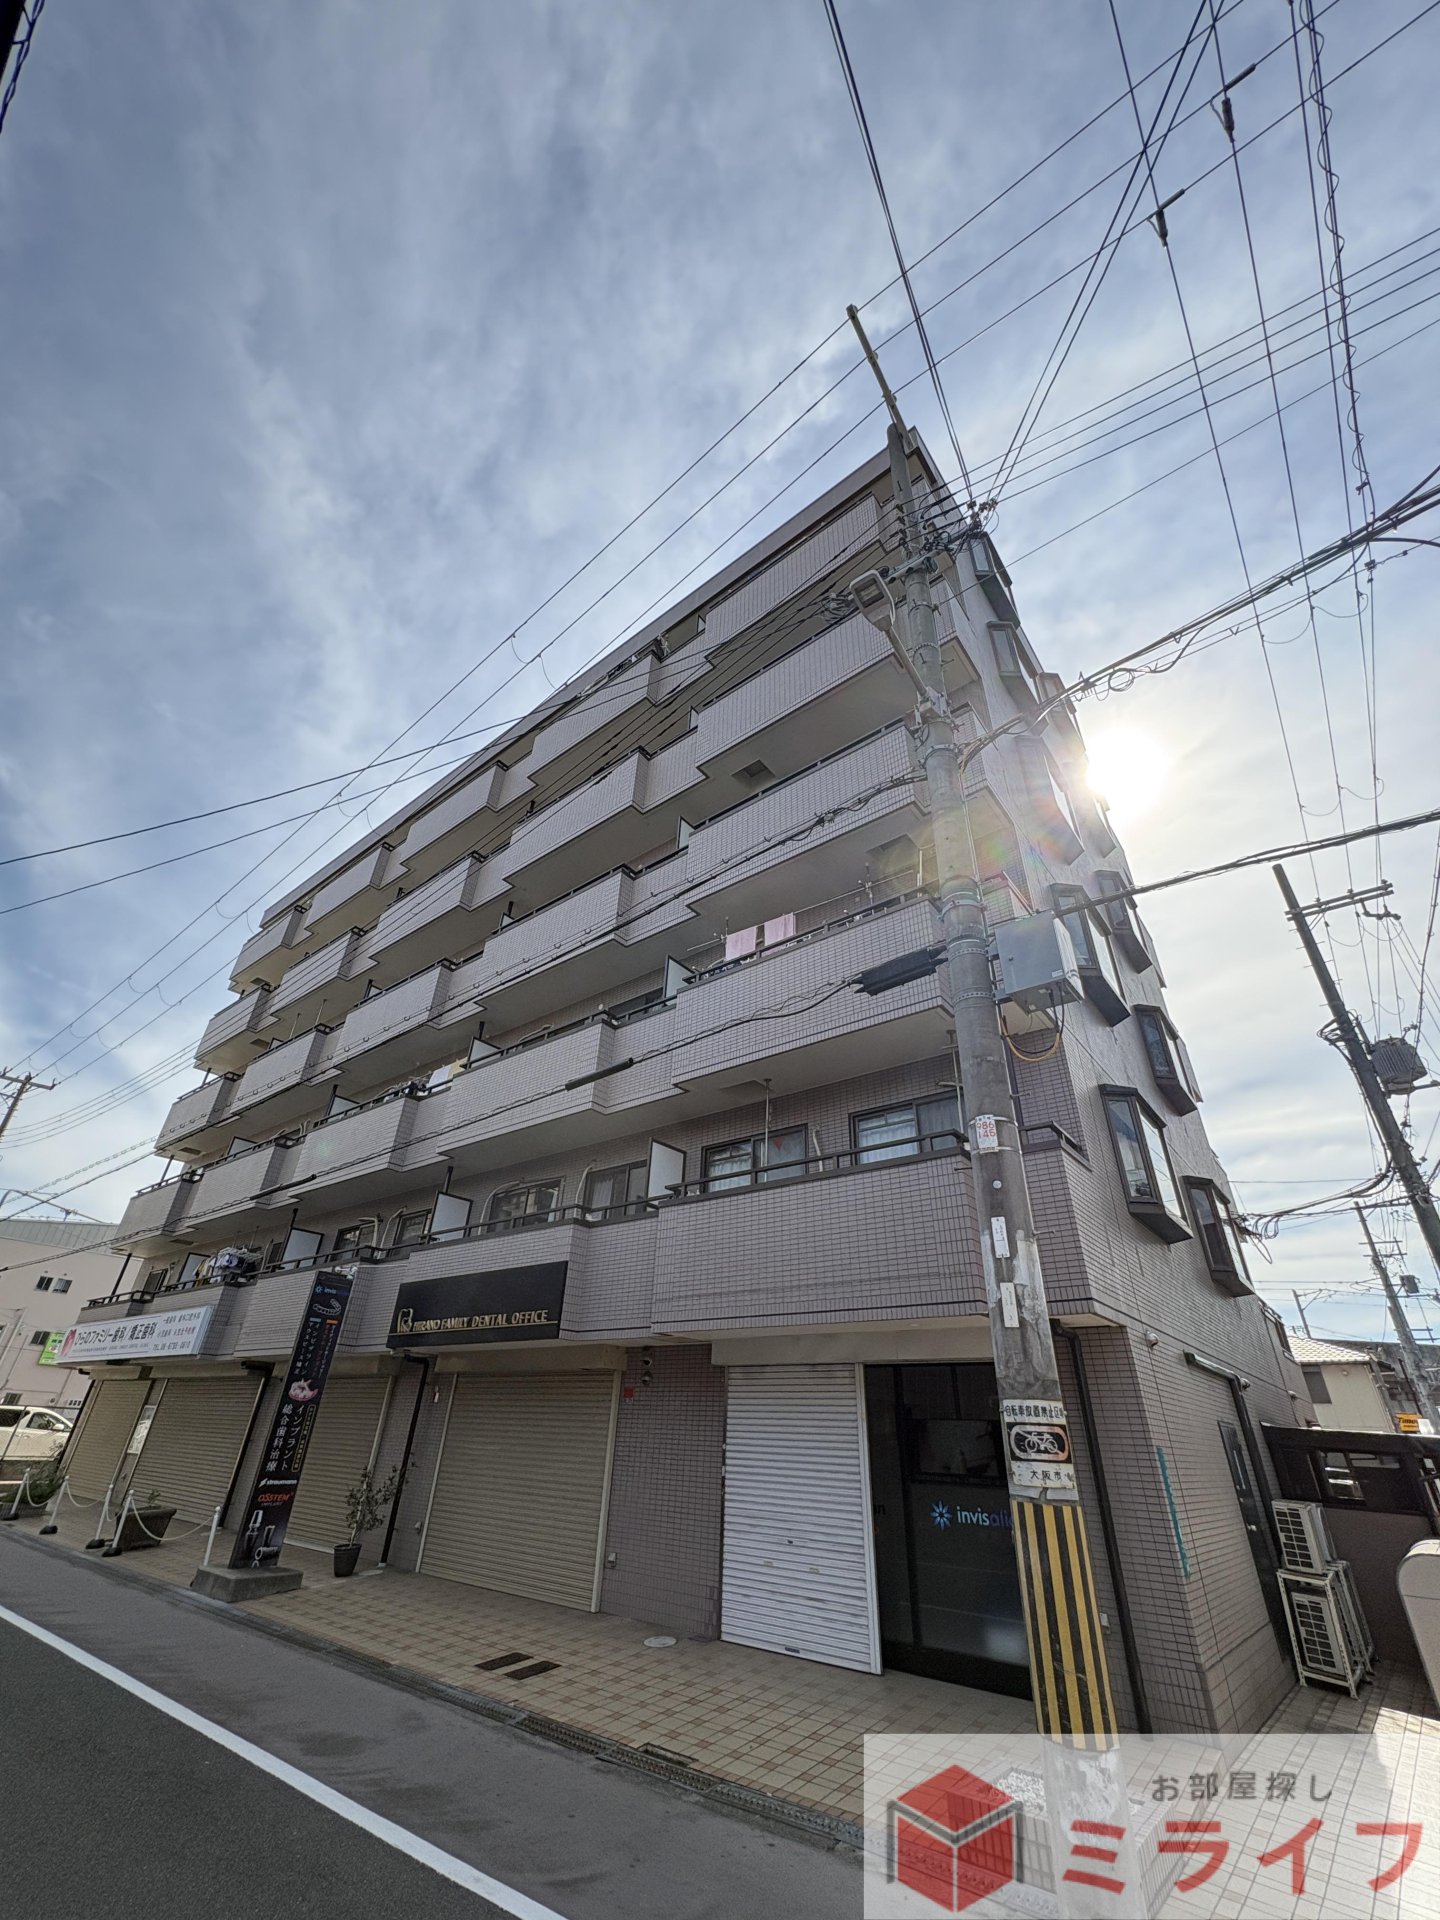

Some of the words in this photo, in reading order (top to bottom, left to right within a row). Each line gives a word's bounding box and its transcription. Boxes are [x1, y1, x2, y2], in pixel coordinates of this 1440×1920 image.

[976, 1121, 995, 1131] 986
[412, 1318, 441, 1332] HIRANO
[440, 1316, 470, 1330] FAMILY
[471, 1313, 508, 1328] DENTAL
[511, 1309, 549, 1325] OFFICE
[265, 1403, 293, 1472] 総合歯科治療
[281, 1404, 305, 1471] インプラント
[1030, 1469, 1063, 1481] 大阪市
